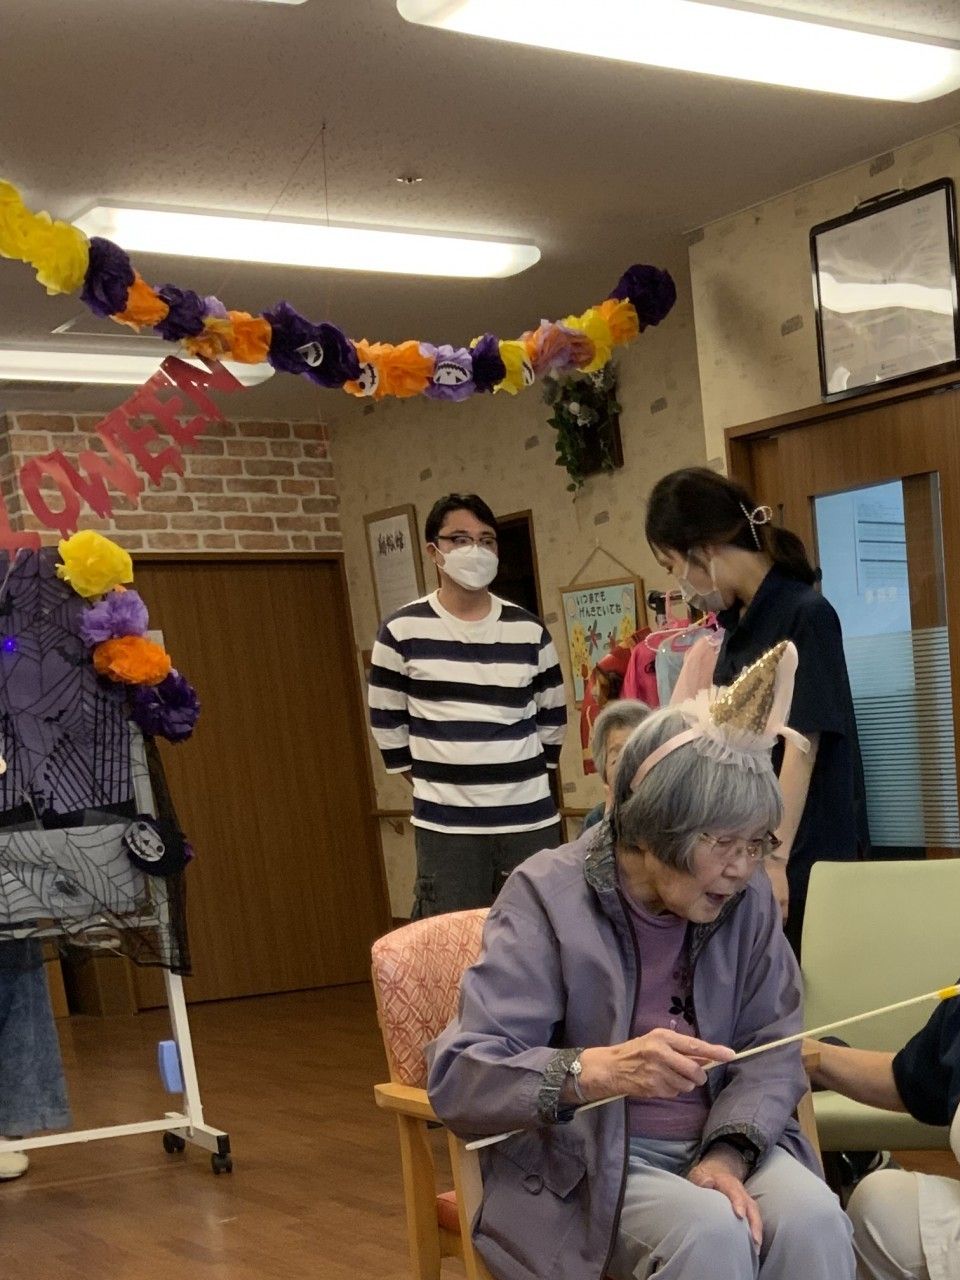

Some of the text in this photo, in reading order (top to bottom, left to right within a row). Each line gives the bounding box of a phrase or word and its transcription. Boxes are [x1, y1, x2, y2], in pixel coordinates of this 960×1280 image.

[576, 590, 606, 605] いつまでも
